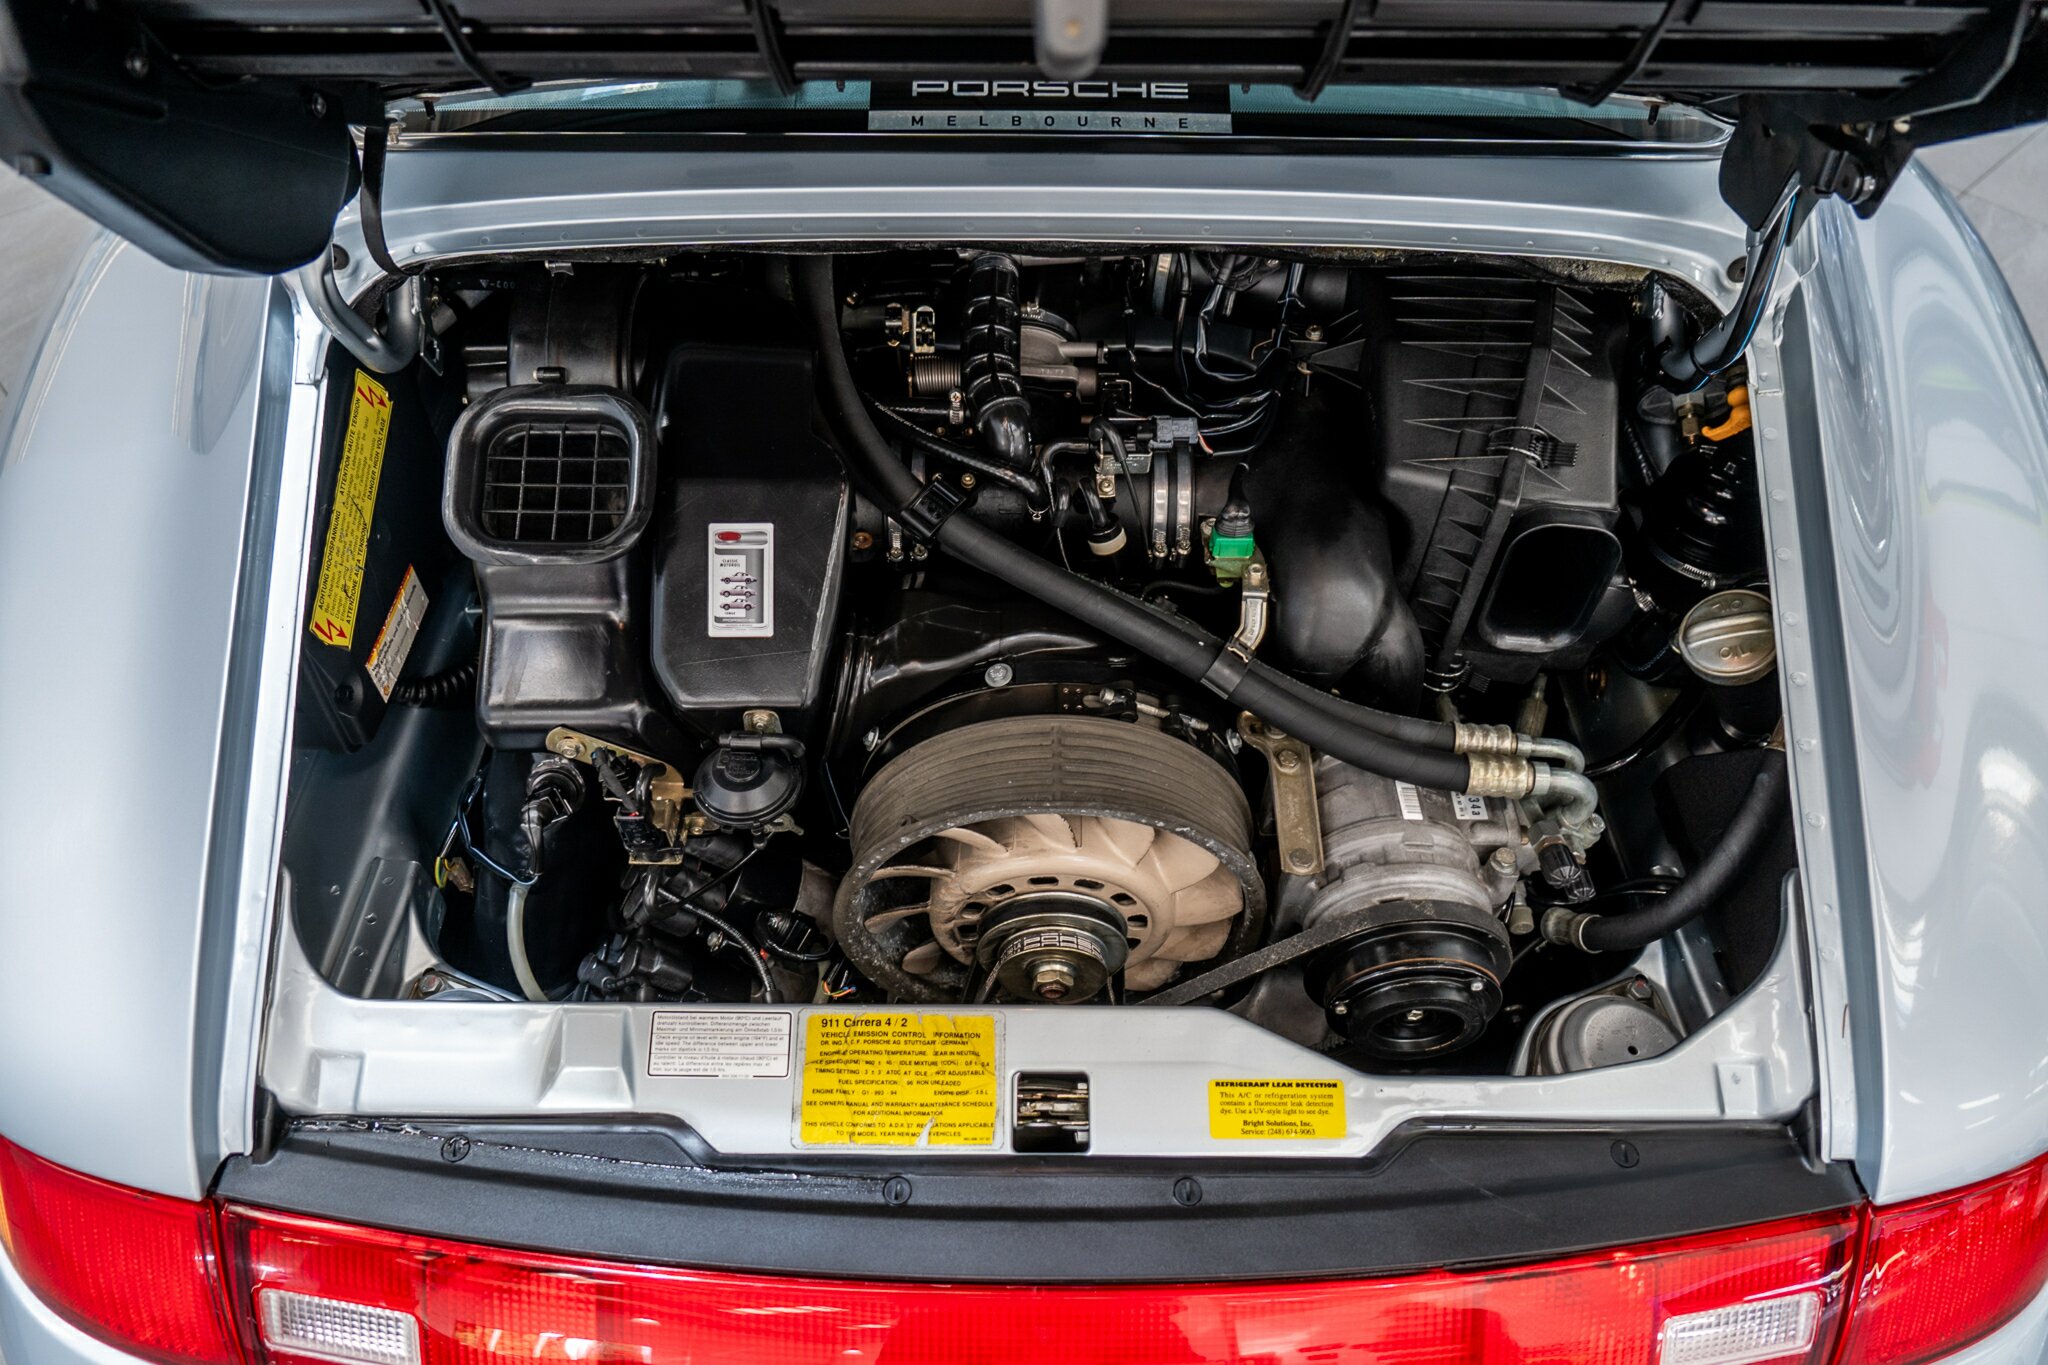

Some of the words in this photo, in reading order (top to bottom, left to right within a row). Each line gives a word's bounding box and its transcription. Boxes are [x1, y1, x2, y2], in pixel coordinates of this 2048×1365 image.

[912, 80, 1189, 99] PORSCHE
[911, 115, 1189, 129] MELBOURNE
[339, 455, 351, 496] ATTENTION
[347, 430, 355, 454] HAUTE
[351, 397, 361, 428] TENSION
[367, 470, 377, 501] DANGER
[376, 417, 386, 449] VOLTAGE
[318, 573, 329, 610] ACHTUNG
[326, 510, 340, 572] HOCHSPANNUNG
[346, 579, 358, 624] ATTENZIONE
[358, 520, 368, 556] TENSIONE
[1719, 645, 1752, 660] OIL
[821, 1018, 839, 1028] 911
[844, 1018, 882, 1028] Carrera
[885, 1018, 891, 1027] 4
[901, 1018, 908, 1027] 2
[821, 1031, 850, 1039] VEHICLE
[1265, 1092, 1307, 1100] refrigeration
[1268, 1128, 1285, 1136] (248)
